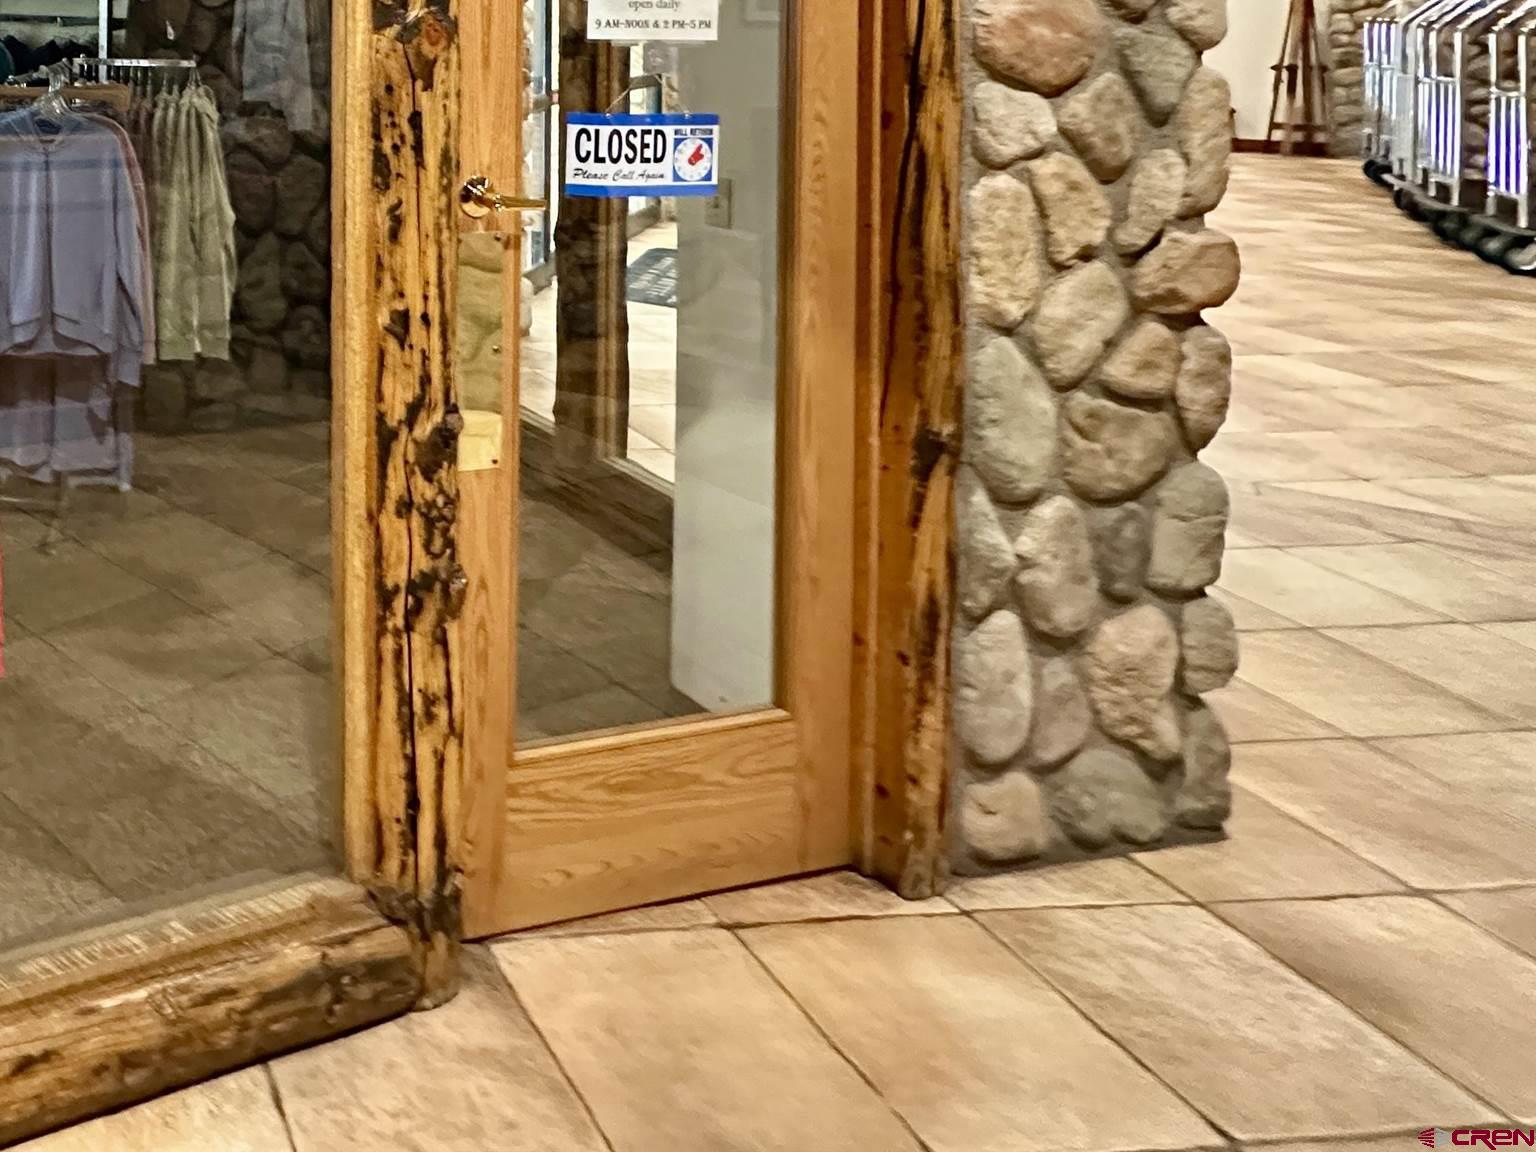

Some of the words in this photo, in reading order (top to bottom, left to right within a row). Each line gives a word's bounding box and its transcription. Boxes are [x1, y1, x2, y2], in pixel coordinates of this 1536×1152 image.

[628, 0, 654, 11] open
[595, 19, 602, 29] 9
[699, 20, 712, 29] PM
[574, 127, 667, 165] CLOSED
[573, 168, 609, 180] Please
[612, 169, 634, 182] Call
[637, 169, 665, 182] Again
